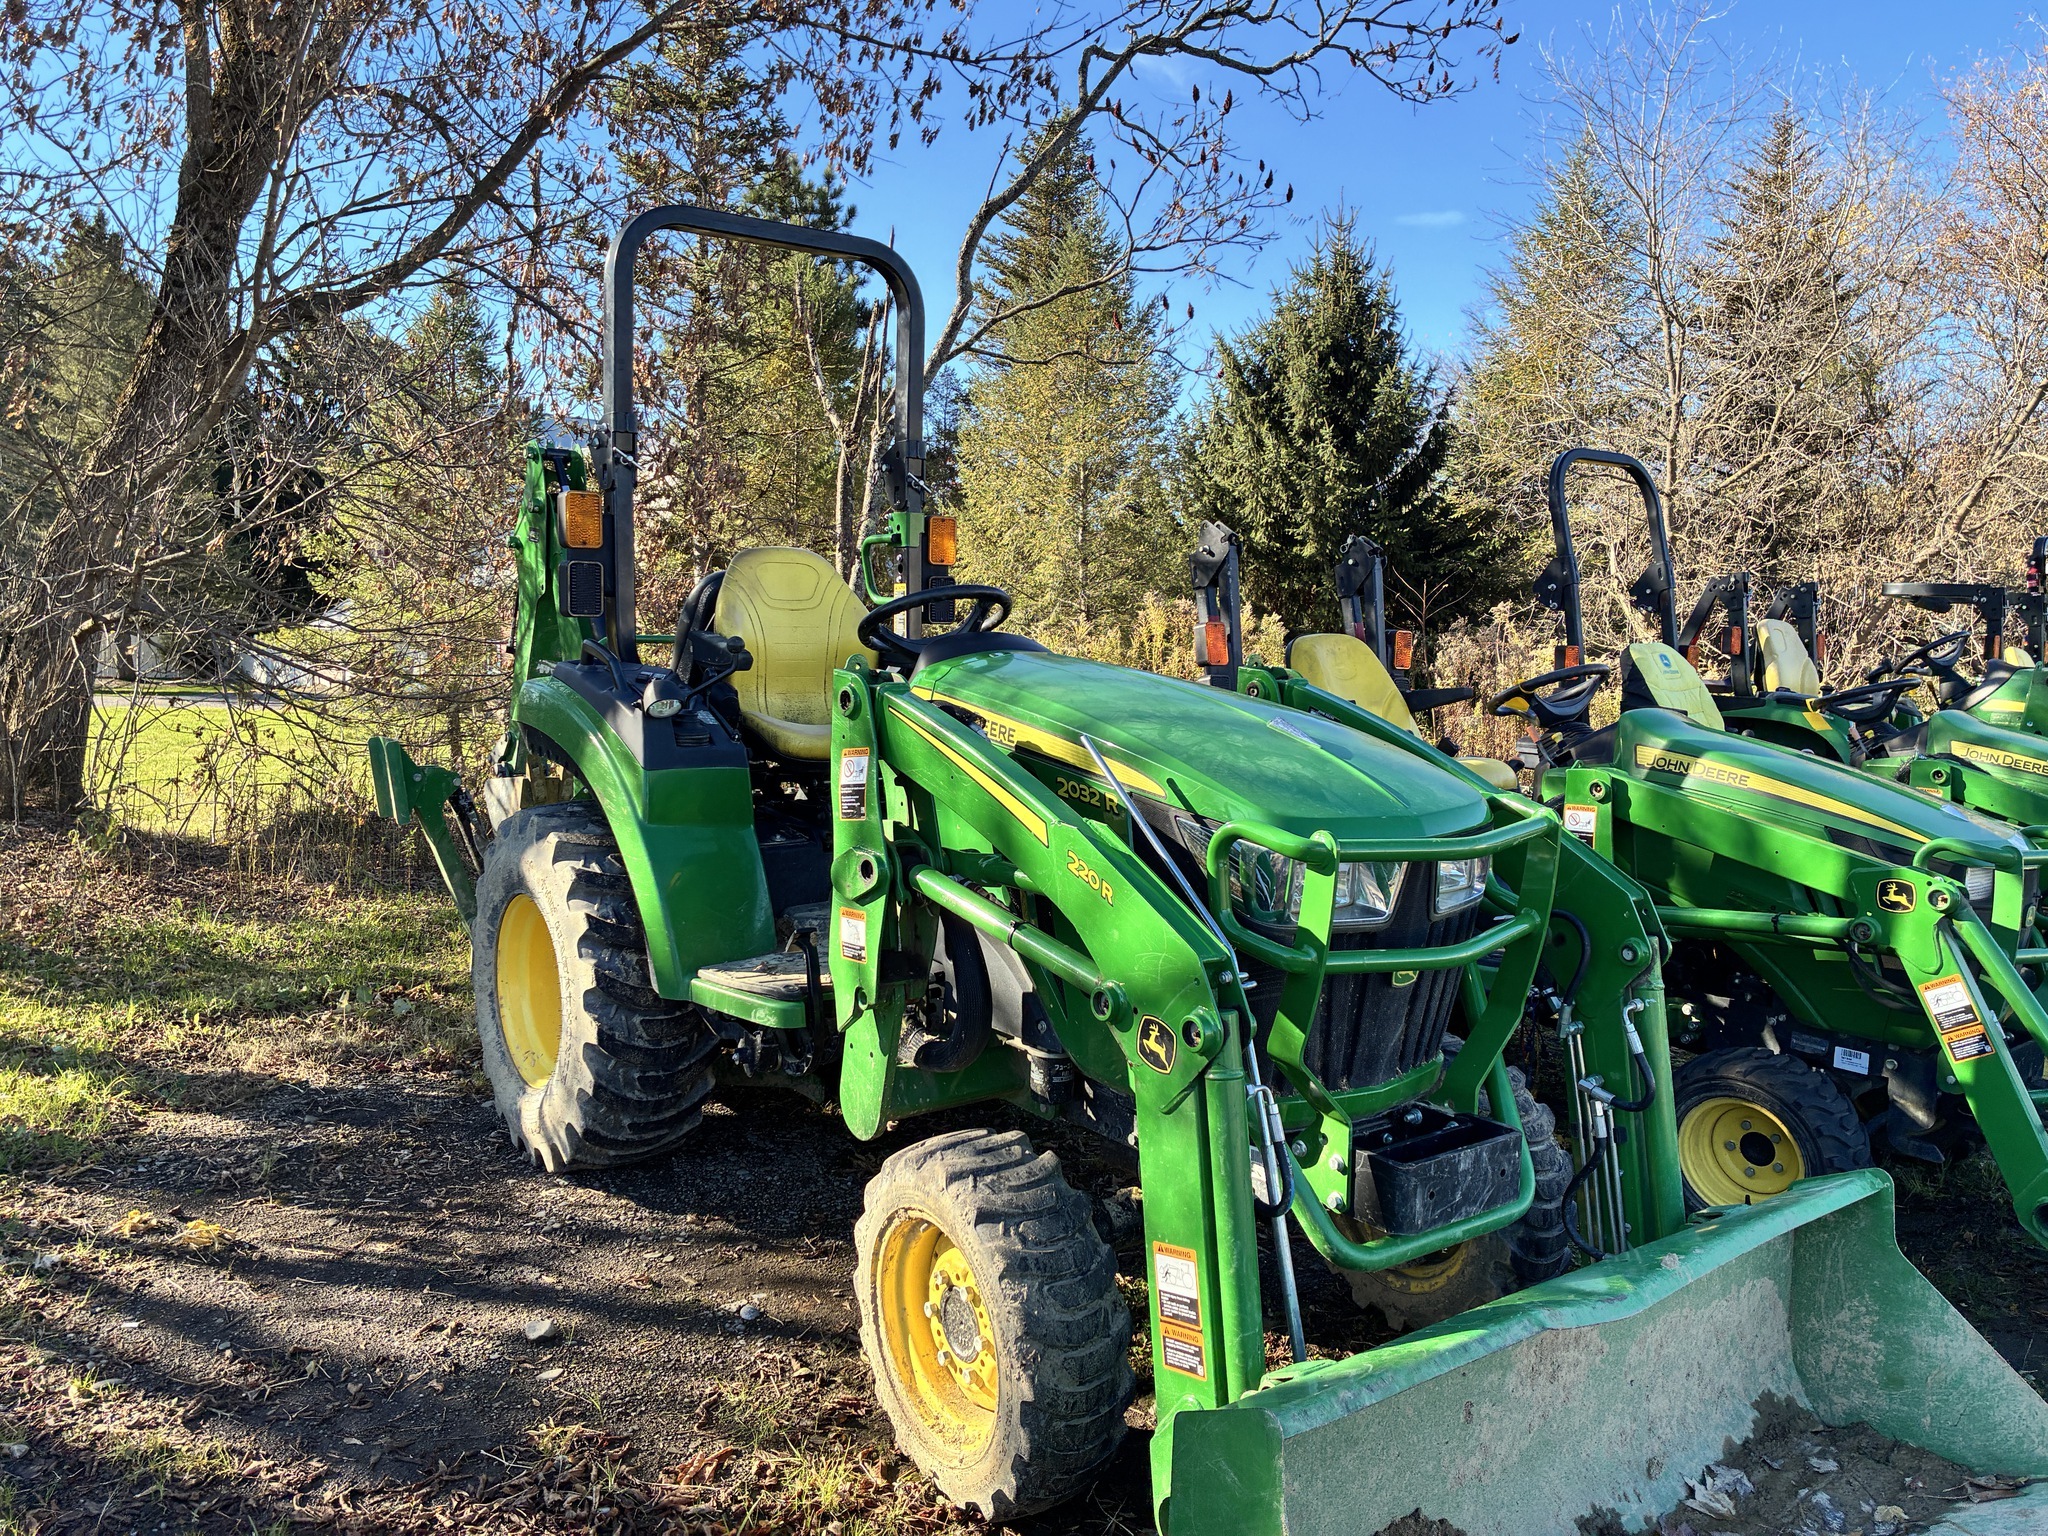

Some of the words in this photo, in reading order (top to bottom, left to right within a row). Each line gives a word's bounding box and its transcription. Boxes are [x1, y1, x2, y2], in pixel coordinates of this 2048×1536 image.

[1961, 747, 2001, 763] JOHN
[2002, 754, 2048, 774] DEERE
[1647, 754, 1691, 773] JOHN
[1692, 761, 1751, 787] DEERE
[1930, 977, 1957, 989] WARNING
[1954, 1028, 1981, 1039] WARNING
[1164, 1246, 1192, 1259] WARNING
[1171, 1327, 1199, 1344] WARNING
